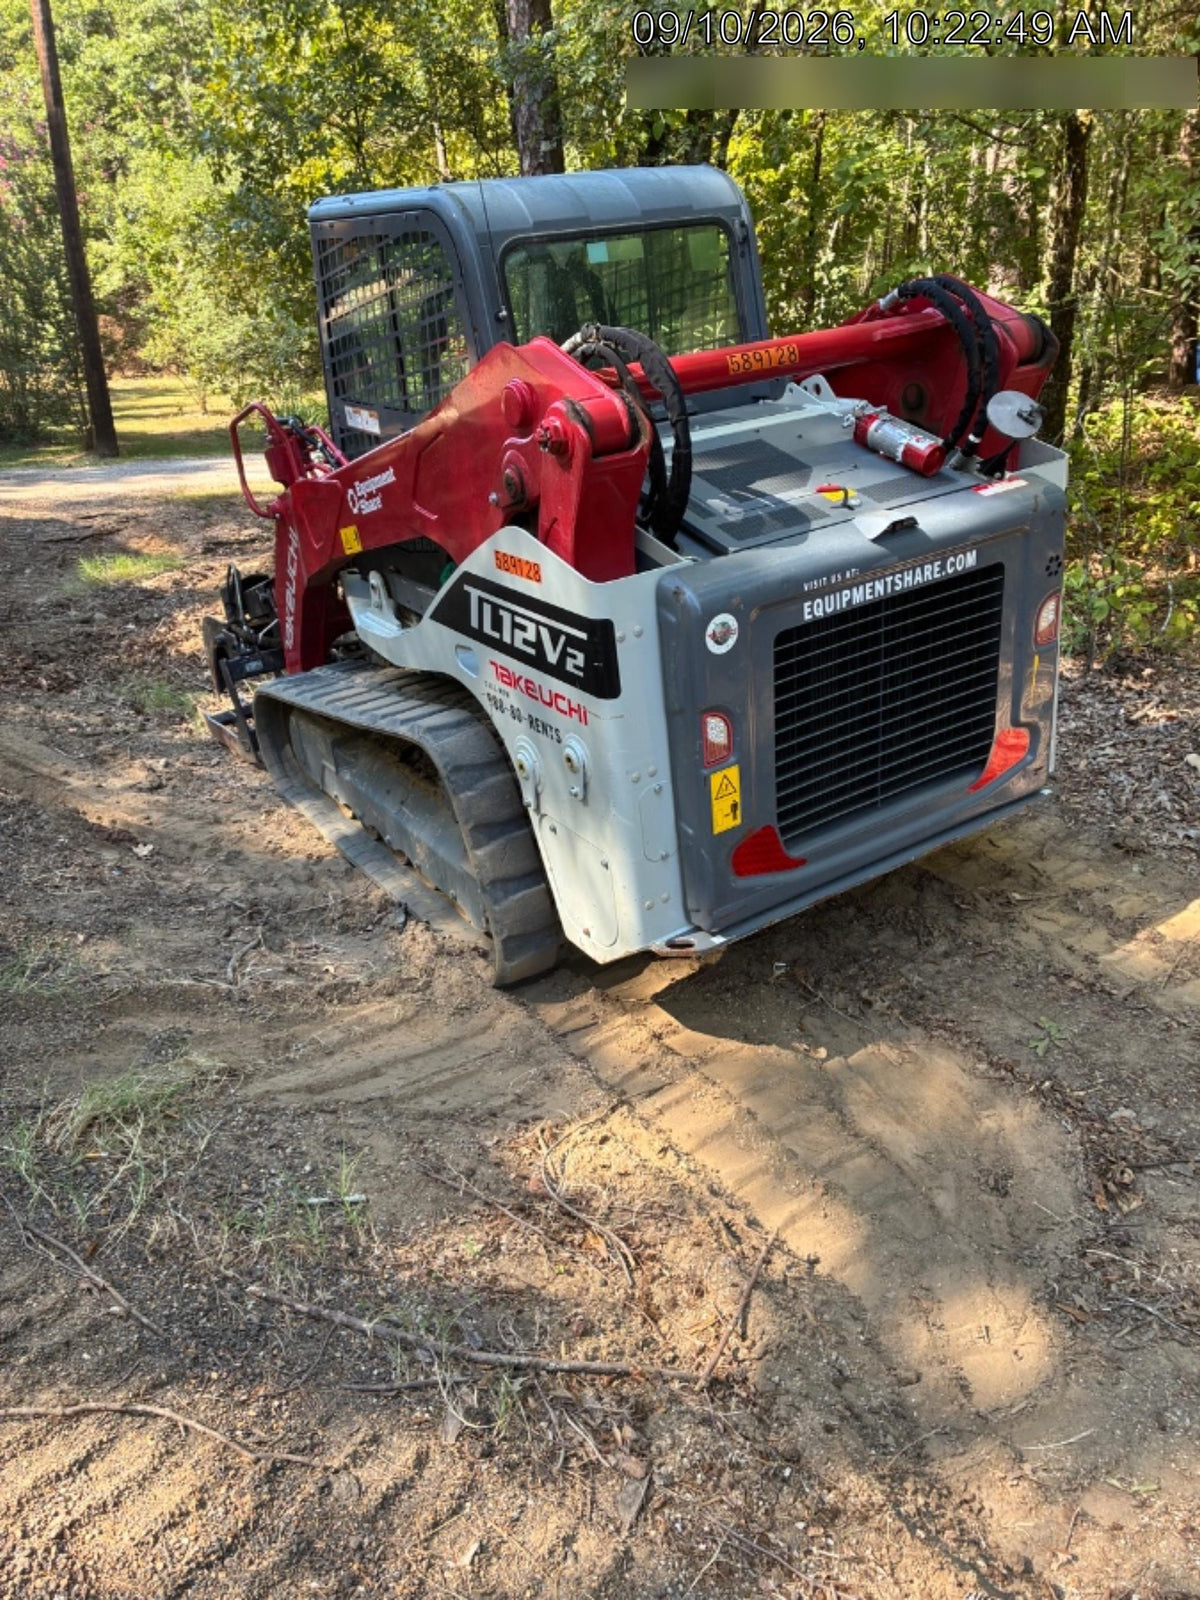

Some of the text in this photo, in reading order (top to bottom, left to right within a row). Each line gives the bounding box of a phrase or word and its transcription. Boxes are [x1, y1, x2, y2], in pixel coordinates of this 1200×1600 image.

[729, 343, 797, 373] 589128
[803, 549, 977, 620] EQUIPMENTSHARE.COM
[463, 584, 588, 677] TL12V2
